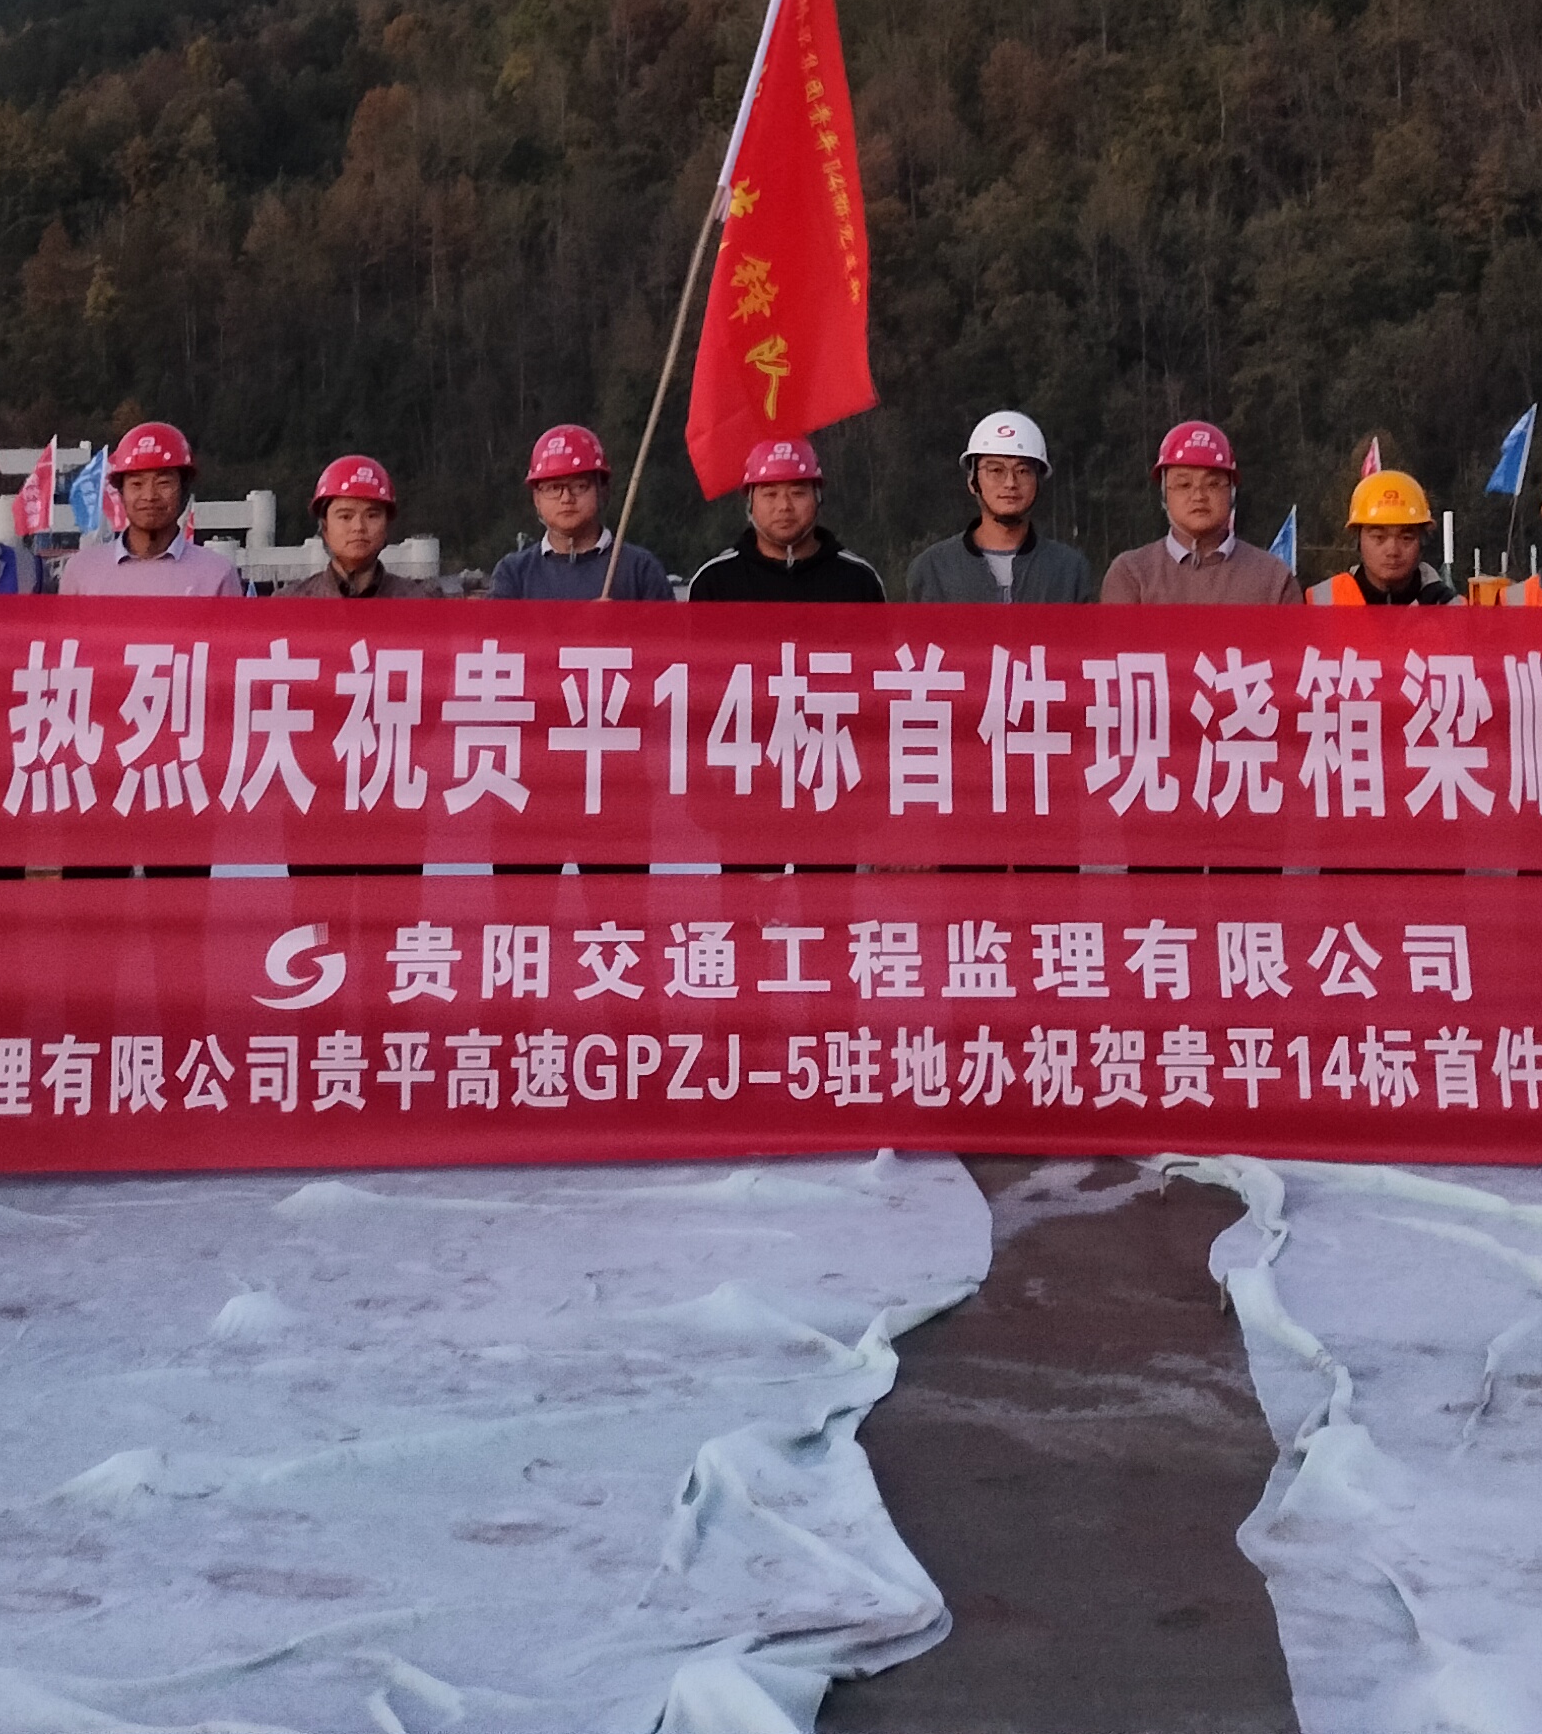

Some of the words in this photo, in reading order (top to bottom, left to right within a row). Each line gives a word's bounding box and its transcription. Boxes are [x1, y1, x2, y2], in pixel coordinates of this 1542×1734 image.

[385, 918, 1474, 1005] 贵阳交通工程监理有限公司
